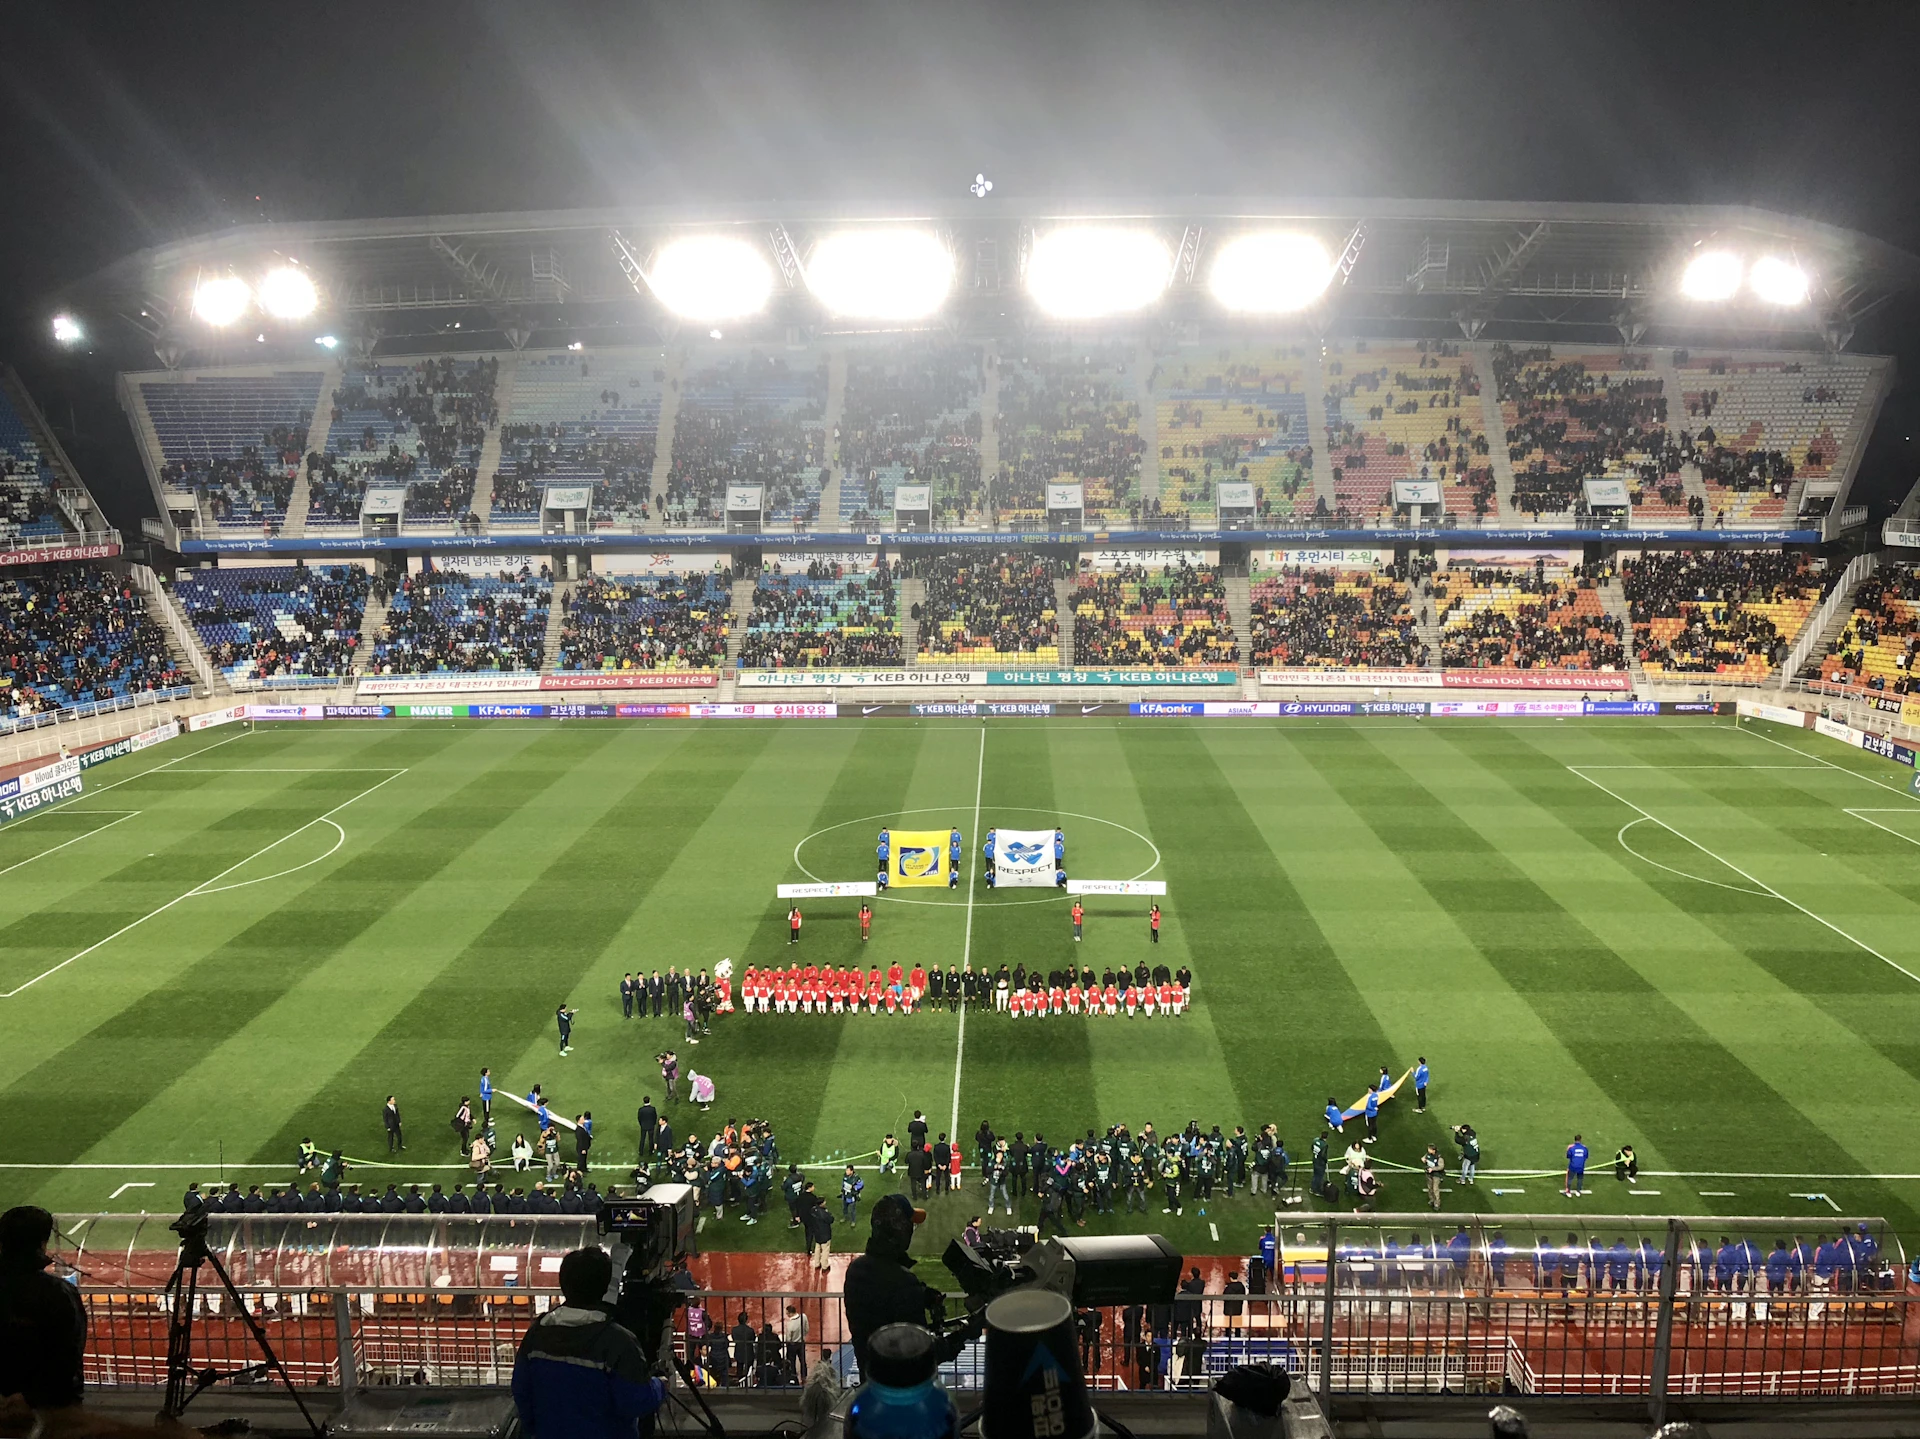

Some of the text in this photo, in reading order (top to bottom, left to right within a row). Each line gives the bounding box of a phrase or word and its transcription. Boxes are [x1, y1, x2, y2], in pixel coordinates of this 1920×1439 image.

[899, 534, 911, 542] KEB
[912, 534, 936, 543] 하나은행
[952, 534, 993, 543] 축구국가대표팀
[994, 533, 1018, 543] 친선경기
[1021, 533, 1049, 543] 대한민국
[1059, 533, 1087, 543] 콜롬비아
[0, 545, 109, 565] Can Do! KEB 하나은행
[778, 551, 873, 562] 안전하고 따뜻한 경기도
[1099, 548, 1184, 561] 스포츠 메카 수원
[1295, 550, 1372, 564] 휴먼시티 수원
[441, 555, 534, 567] 일자리 넘치는 경기도
[545, 676, 712, 687] 하나 Can Do! KEB 하나은행
[757, 672, 970, 685] 하나된 평창 KEB 하나은행
[1004, 672, 1218, 684] 하나된 평창 KEB 하나은행
[1267, 674, 1433, 684] 대한민국 자존심 태극전사 힘내라!
[1446, 676, 1624, 687] 하나 Can Do! KEB 하나은행
[366, 679, 532, 691] 대한민국 자존심 태극전사 힘내라!
[226, 707, 244, 719] kt 5G
[326, 707, 385, 716] 파워에이드
[410, 706, 453, 716] NAVER
[550, 705, 586, 716] 교보생명
[785, 705, 826, 715] 서울우유
[927, 704, 977, 714] KEB 하나은행
[1000, 704, 1050, 714] KEB 하나은행
[1304, 705, 1350, 713] HYUNDAI
[1373, 703, 1425, 713] KEB 하나은행
[1633, 703, 1656, 712] KFA
[1824, 725, 1846, 736] RESPECT
[90, 740, 131, 763] KEB 하나은행
[1864, 735, 1894, 758] 교보생명
[1896, 753, 1912, 764] KYOBO
[55, 760, 78, 776] 클라우드
[17, 776, 82, 812] KEB 하나은행
[998, 863, 1052, 875] RESPECT
